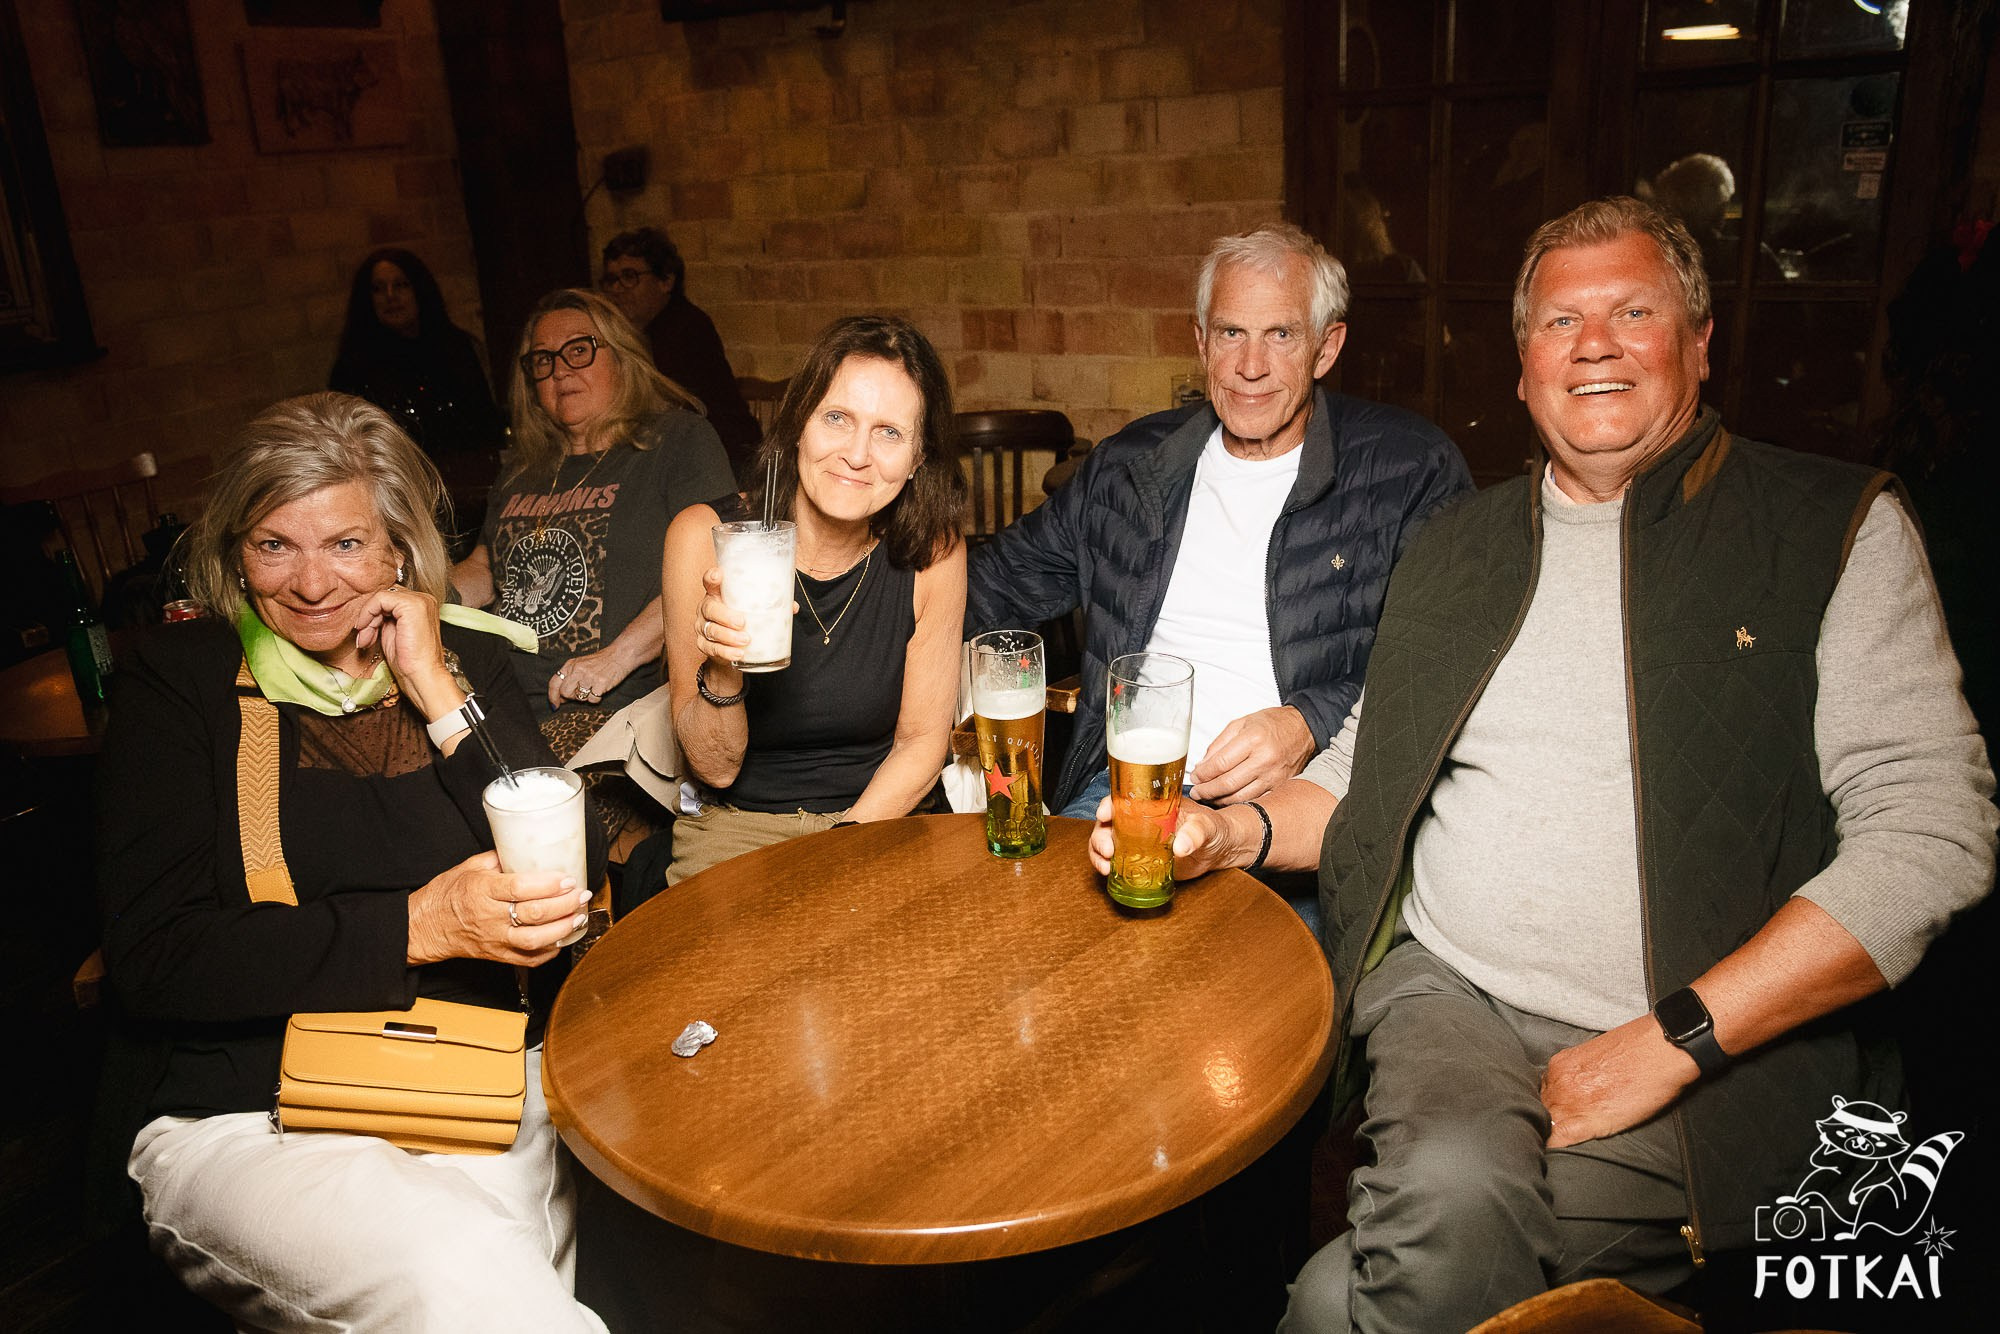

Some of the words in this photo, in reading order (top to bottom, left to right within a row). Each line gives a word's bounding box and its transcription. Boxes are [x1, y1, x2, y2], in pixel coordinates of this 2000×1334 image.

[500, 483, 620, 519] RAMONES
[517, 531, 573, 555] JONNY
[570, 555, 584, 600] JOEY
